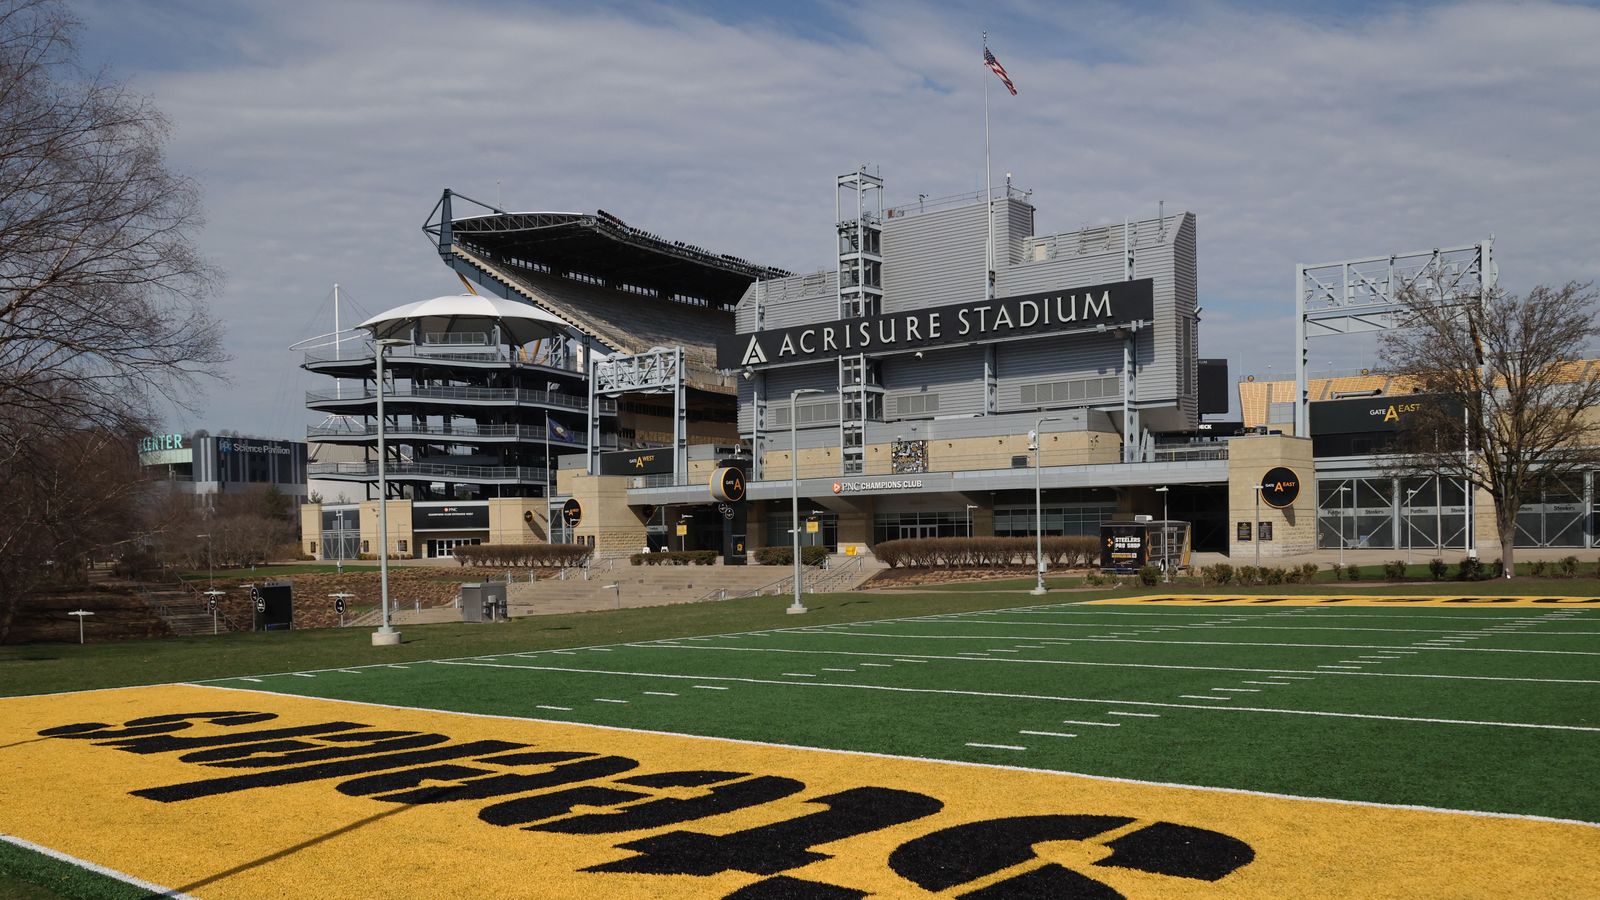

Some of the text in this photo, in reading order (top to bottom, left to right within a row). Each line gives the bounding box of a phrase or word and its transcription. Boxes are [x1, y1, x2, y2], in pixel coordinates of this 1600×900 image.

[778, 313, 941, 357] ACRISURE
[958, 290, 1113, 336] STADIUM
[1369, 403, 1421, 422] GATE A EAST
[143, 432, 183, 451] CENTER
[233, 443, 263, 453] Science
[263, 444, 291, 455] Pavilion
[635, 456, 644, 468] A
[734, 478, 742, 490] A
[842, 480, 922, 491] PNC CHAMPIONS CLUB
[1274, 482, 1284, 492] A
